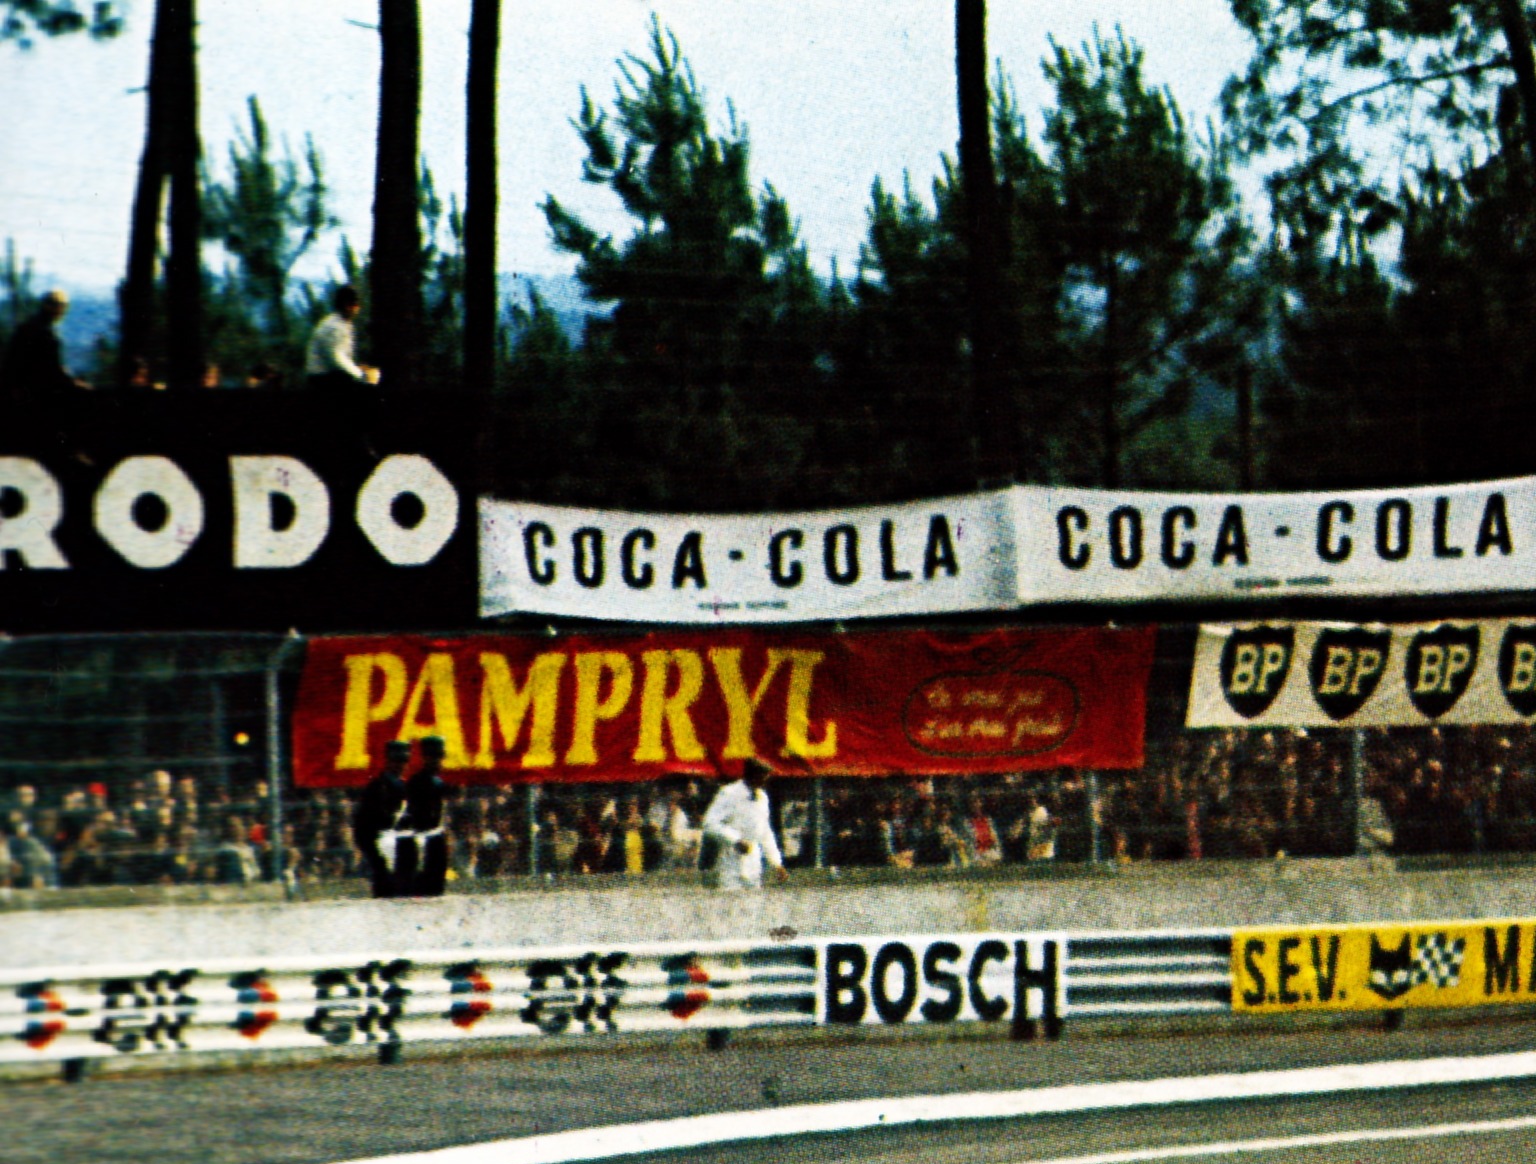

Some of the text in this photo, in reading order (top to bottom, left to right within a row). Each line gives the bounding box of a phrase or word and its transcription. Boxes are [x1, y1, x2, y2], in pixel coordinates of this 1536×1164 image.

[1230, 643, 1289, 694] BP
[1317, 646, 1381, 695] BP
[1412, 644, 1472, 693] BP
[334, 647, 838, 770] PAMPRYL
[825, 940, 1058, 1024] BOSCH
[1242, 935, 1348, 1003] S.E.V.
